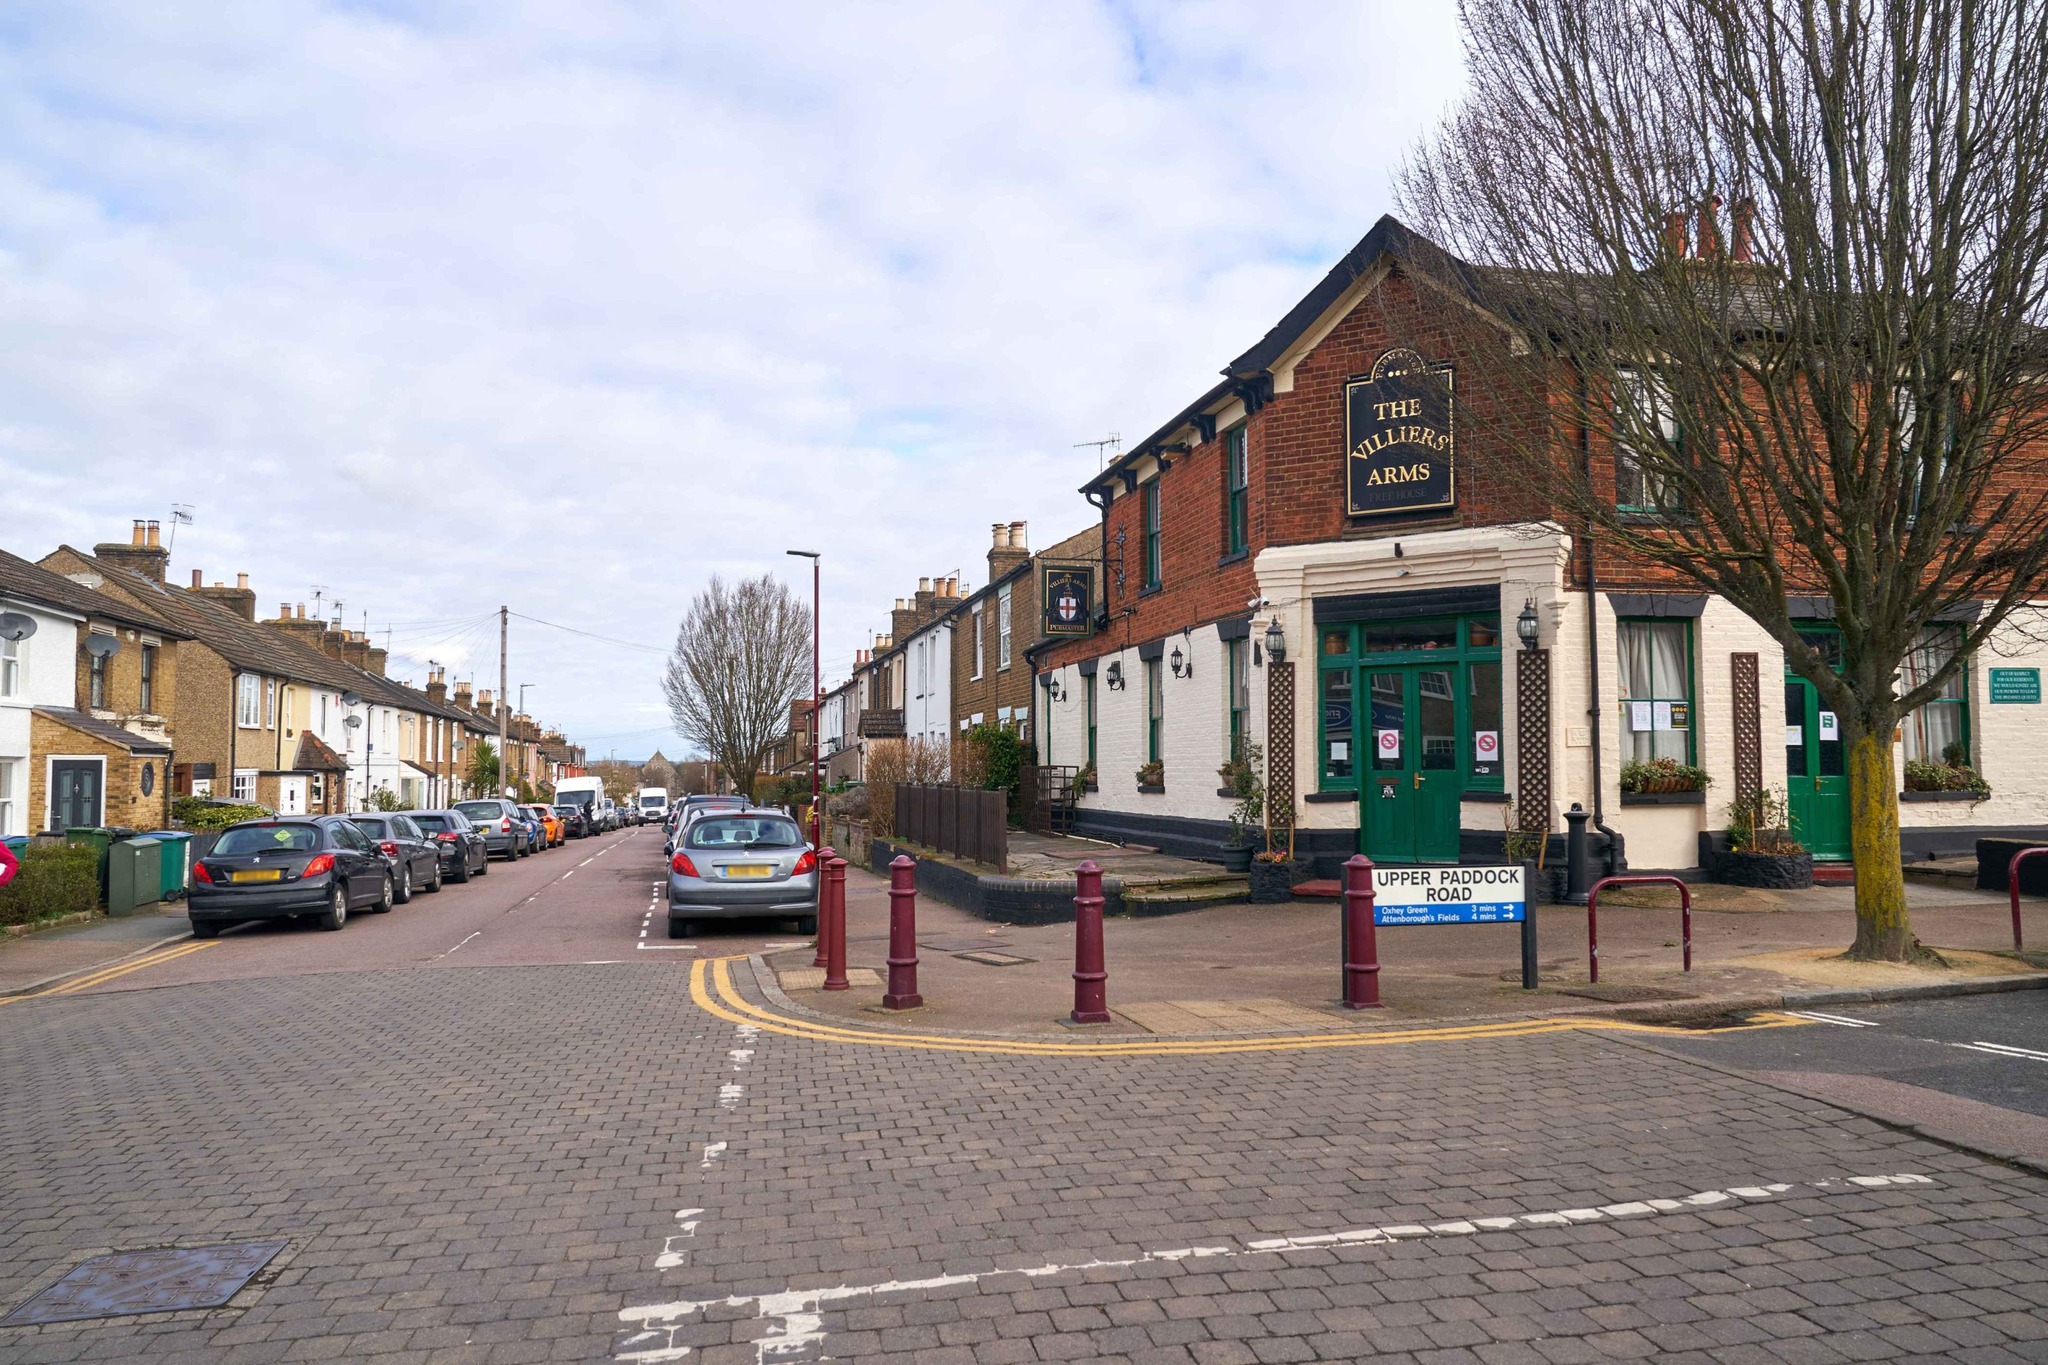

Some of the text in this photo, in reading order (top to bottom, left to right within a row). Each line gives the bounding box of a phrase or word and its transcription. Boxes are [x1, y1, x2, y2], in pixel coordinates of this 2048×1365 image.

[1374, 398, 1422, 420] THE
[1351, 426, 1450, 460] VILLIERS
[1366, 464, 1430, 486] ARMS
[1397, 488, 1427, 500] HOUSE
[1378, 869, 1519, 886] UPPER PADDOCK
[1427, 887, 1472, 901] ROAD
[1382, 907, 1404, 915] Oxhey
[1382, 914, 1435, 923] Attenborough's
